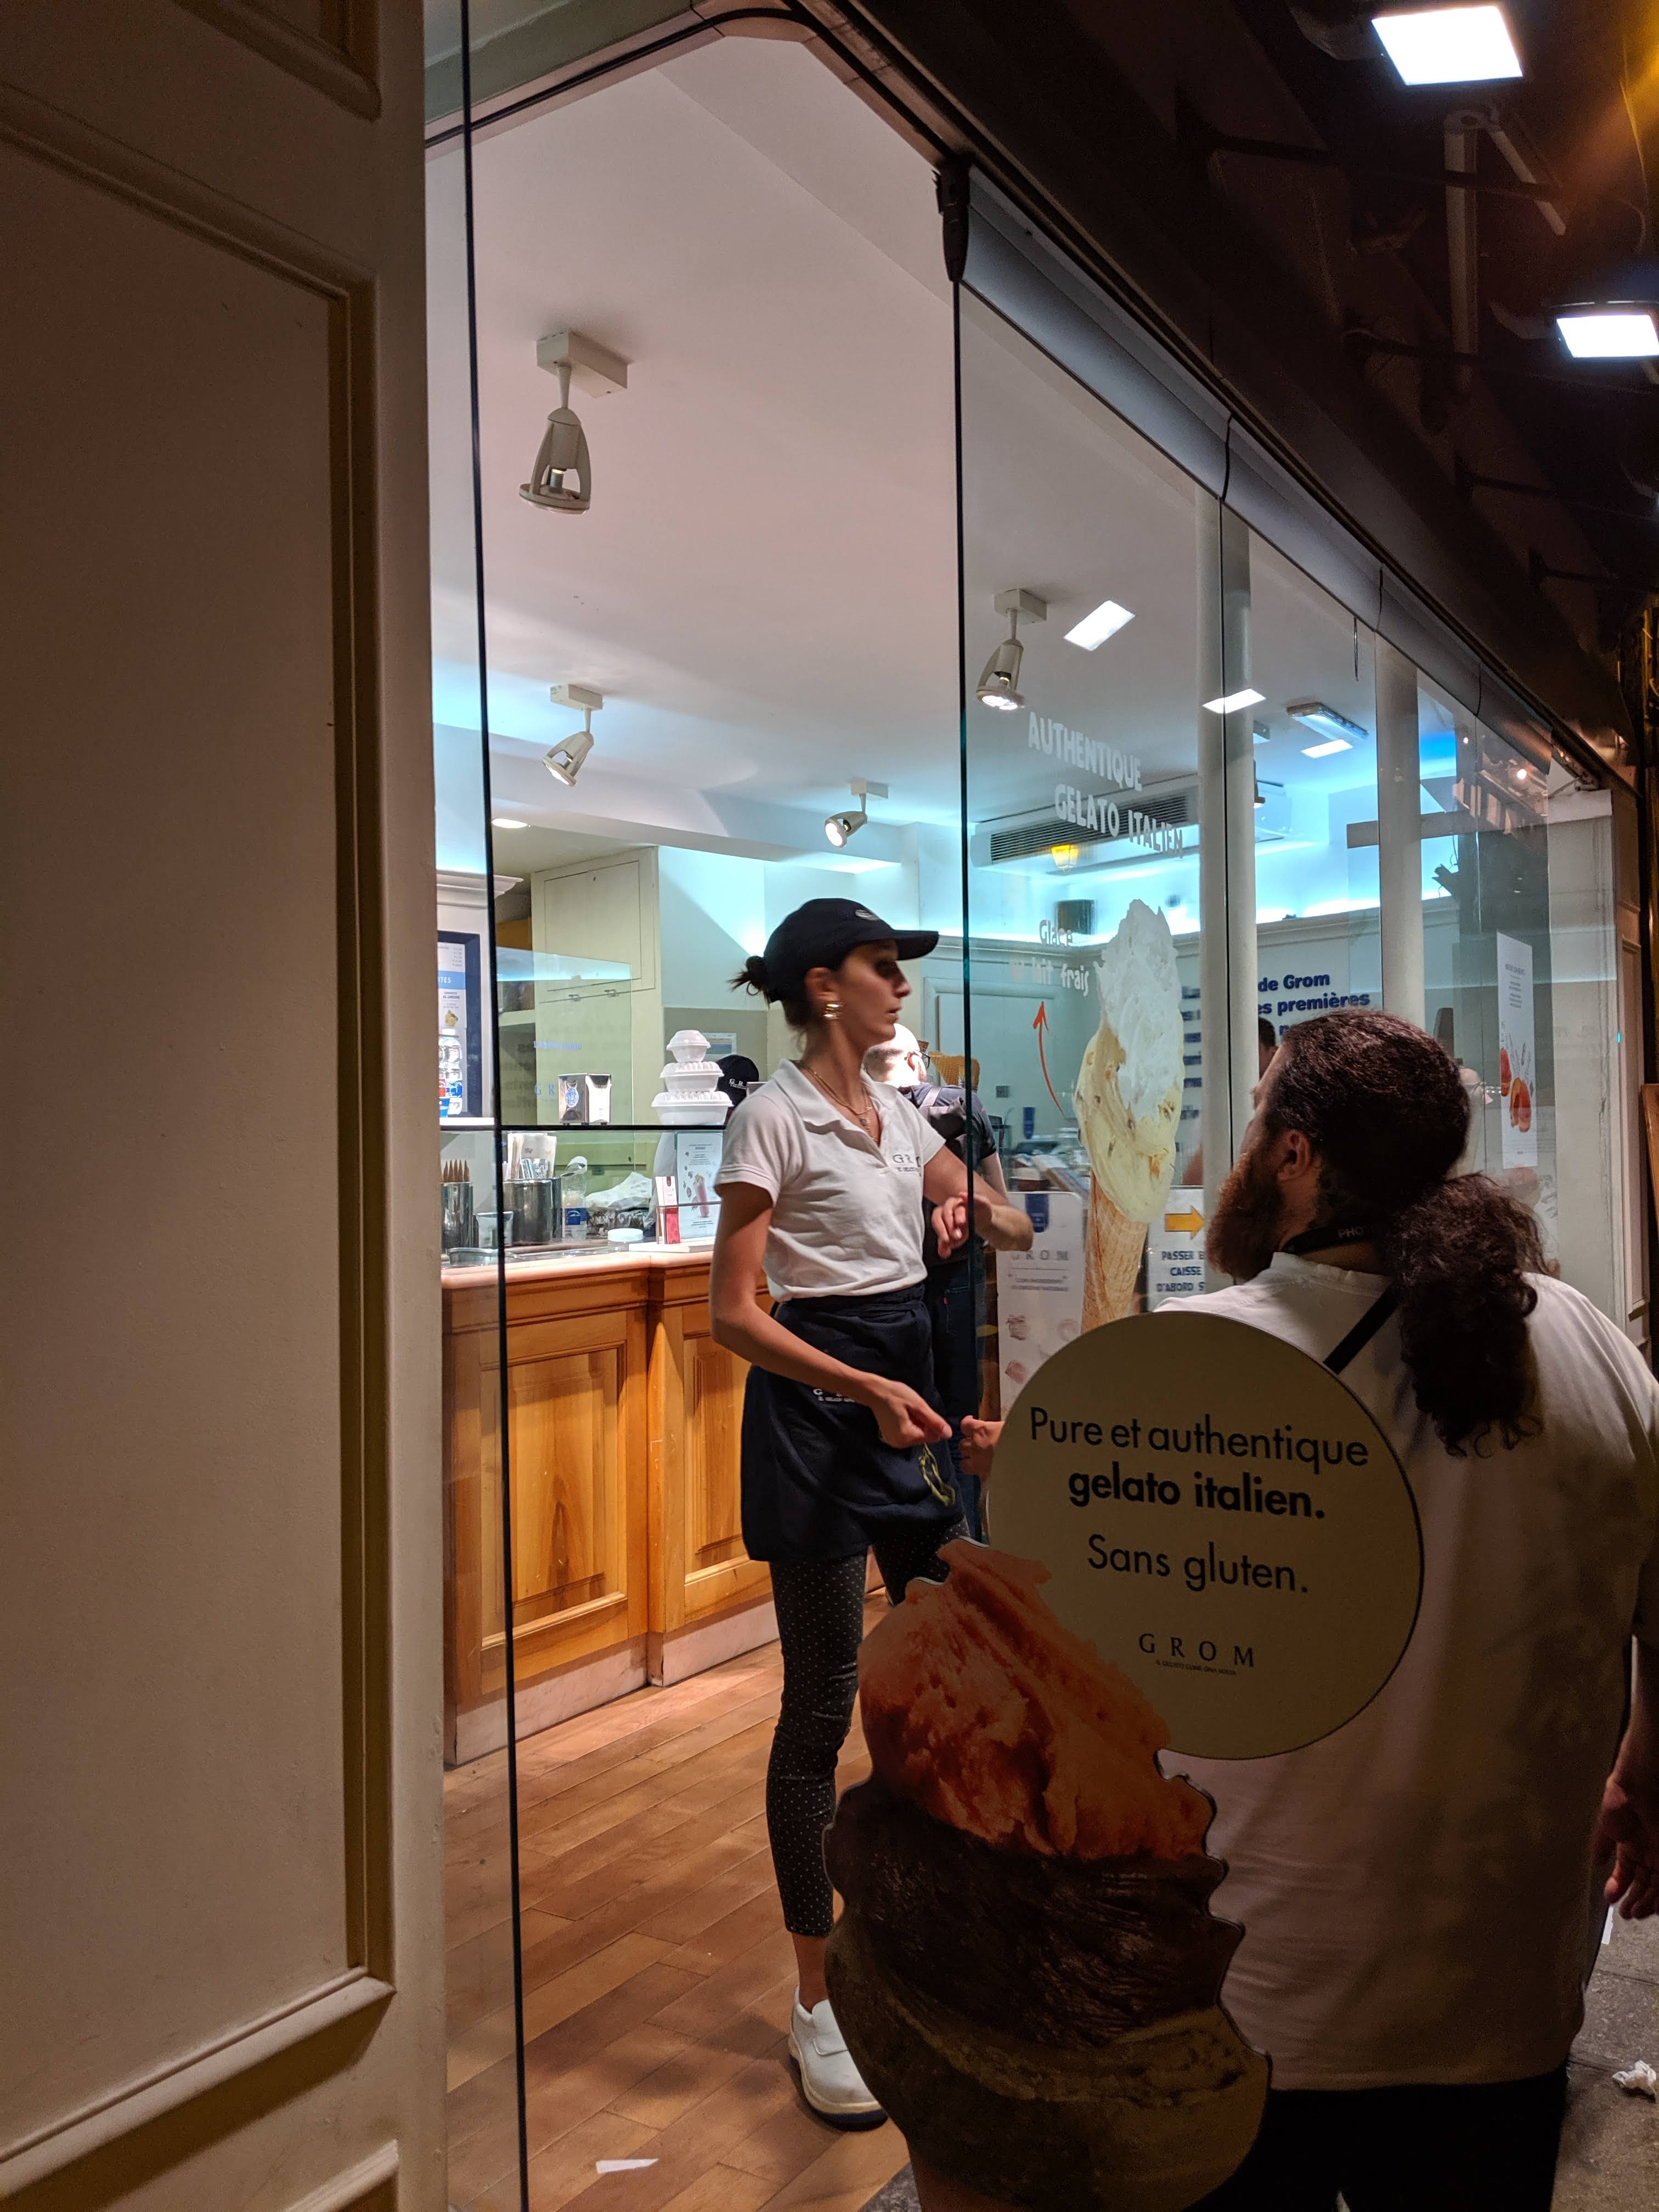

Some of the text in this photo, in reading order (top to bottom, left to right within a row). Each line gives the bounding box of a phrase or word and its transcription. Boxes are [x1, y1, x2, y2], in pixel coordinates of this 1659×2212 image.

[1028, 712, 1142, 791] AUTHENTIQUE
[1054, 784, 1183, 859] GELATO ITALIEN
[1039, 919, 1073, 949] Glace
[1062, 963, 1090, 997] frais
[1283, 974, 1330, 990] Grom
[1277, 991, 1371, 1017] premières
[1156, 1282, 1194, 1292] D'ABORD
[1170, 1266, 1203, 1277] CAISSE
[1030, 1407, 1369, 1475] Pure et authentique
[1068, 1461, 1326, 1519] gelato italien.
[1088, 1535, 1309, 1593] Sans gluten.
[1138, 1633, 1254, 1668] GROM
